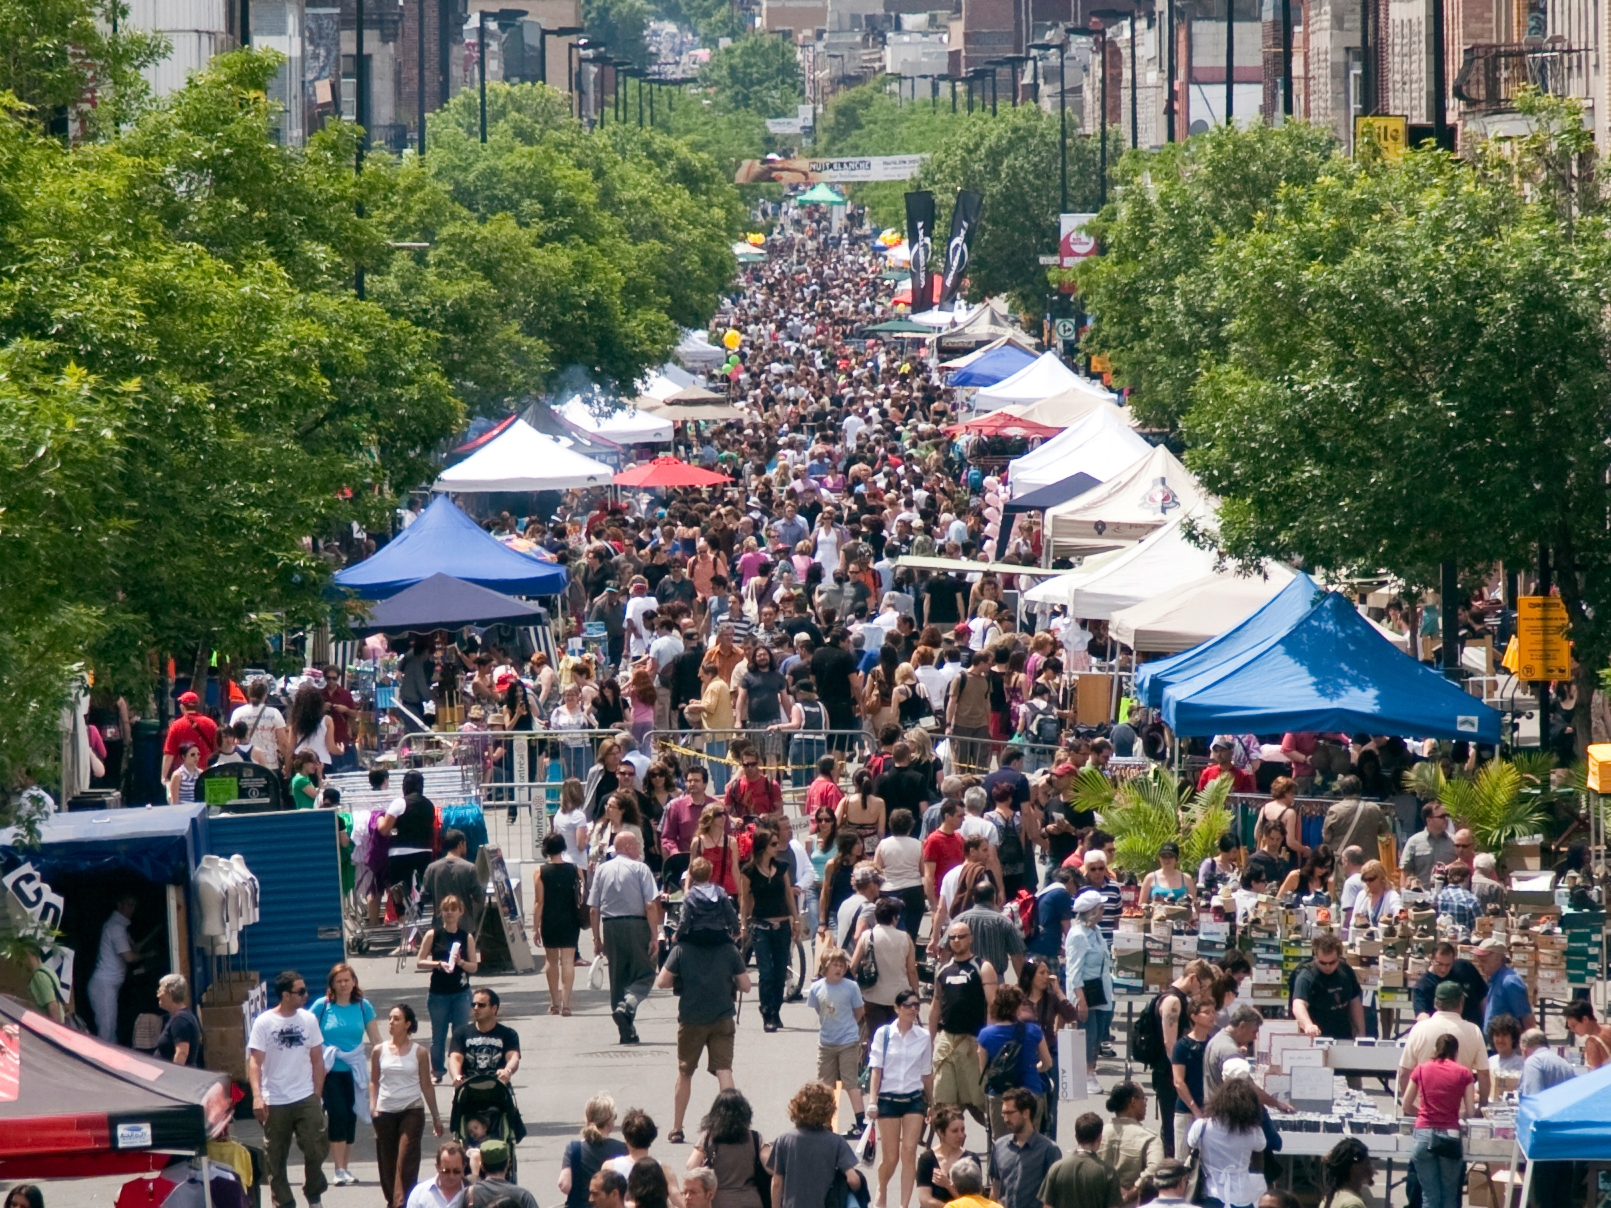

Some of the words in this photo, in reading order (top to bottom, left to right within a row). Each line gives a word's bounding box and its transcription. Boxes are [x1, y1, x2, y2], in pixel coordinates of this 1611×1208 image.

[809, 161, 830, 171] NUIT
[832, 160, 871, 171] BLANCHE
[535, 807, 544, 849] Montréal
[1060, 1068, 1069, 1099] ALDO
